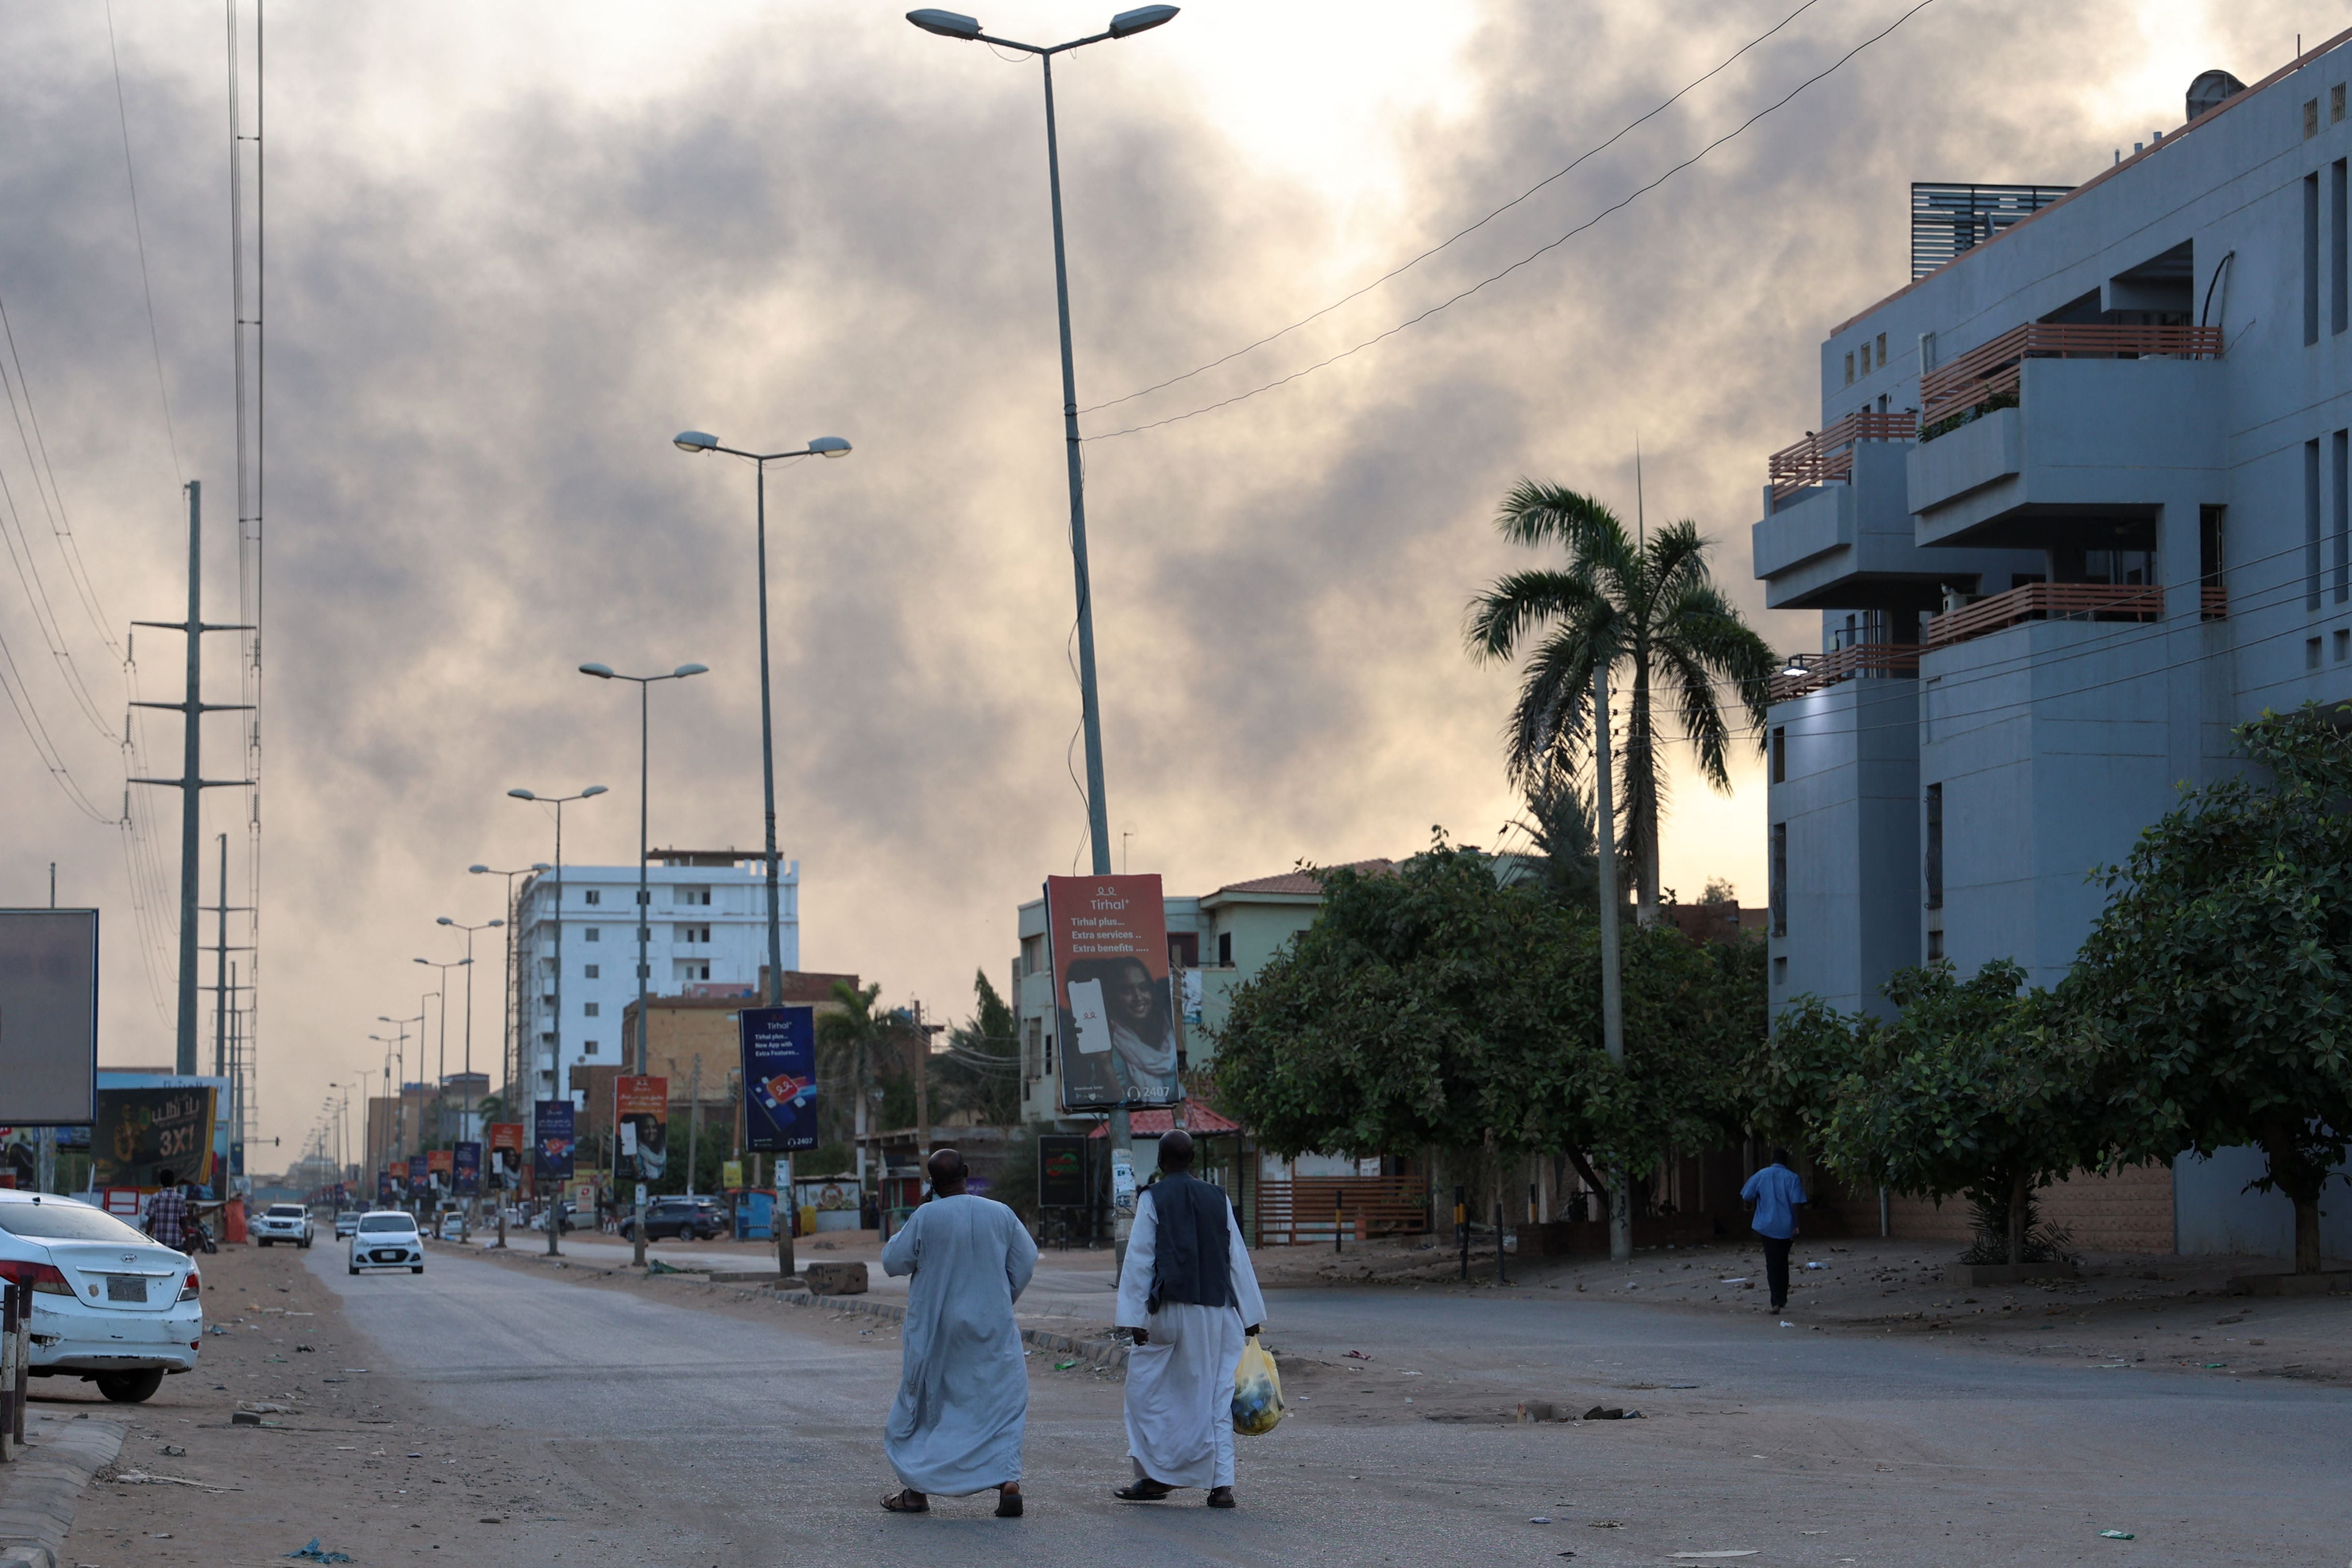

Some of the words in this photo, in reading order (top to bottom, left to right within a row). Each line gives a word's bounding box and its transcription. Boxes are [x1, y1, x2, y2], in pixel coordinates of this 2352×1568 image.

[1071, 917, 1097, 926] Tirhal
[1072, 931, 1094, 940] Extra
[1096, 931, 1134, 939] services
[1073, 944, 1096, 952] Extra
[1097, 943, 1134, 952] benefits
[1143, 1086, 1170, 1097] 2407
